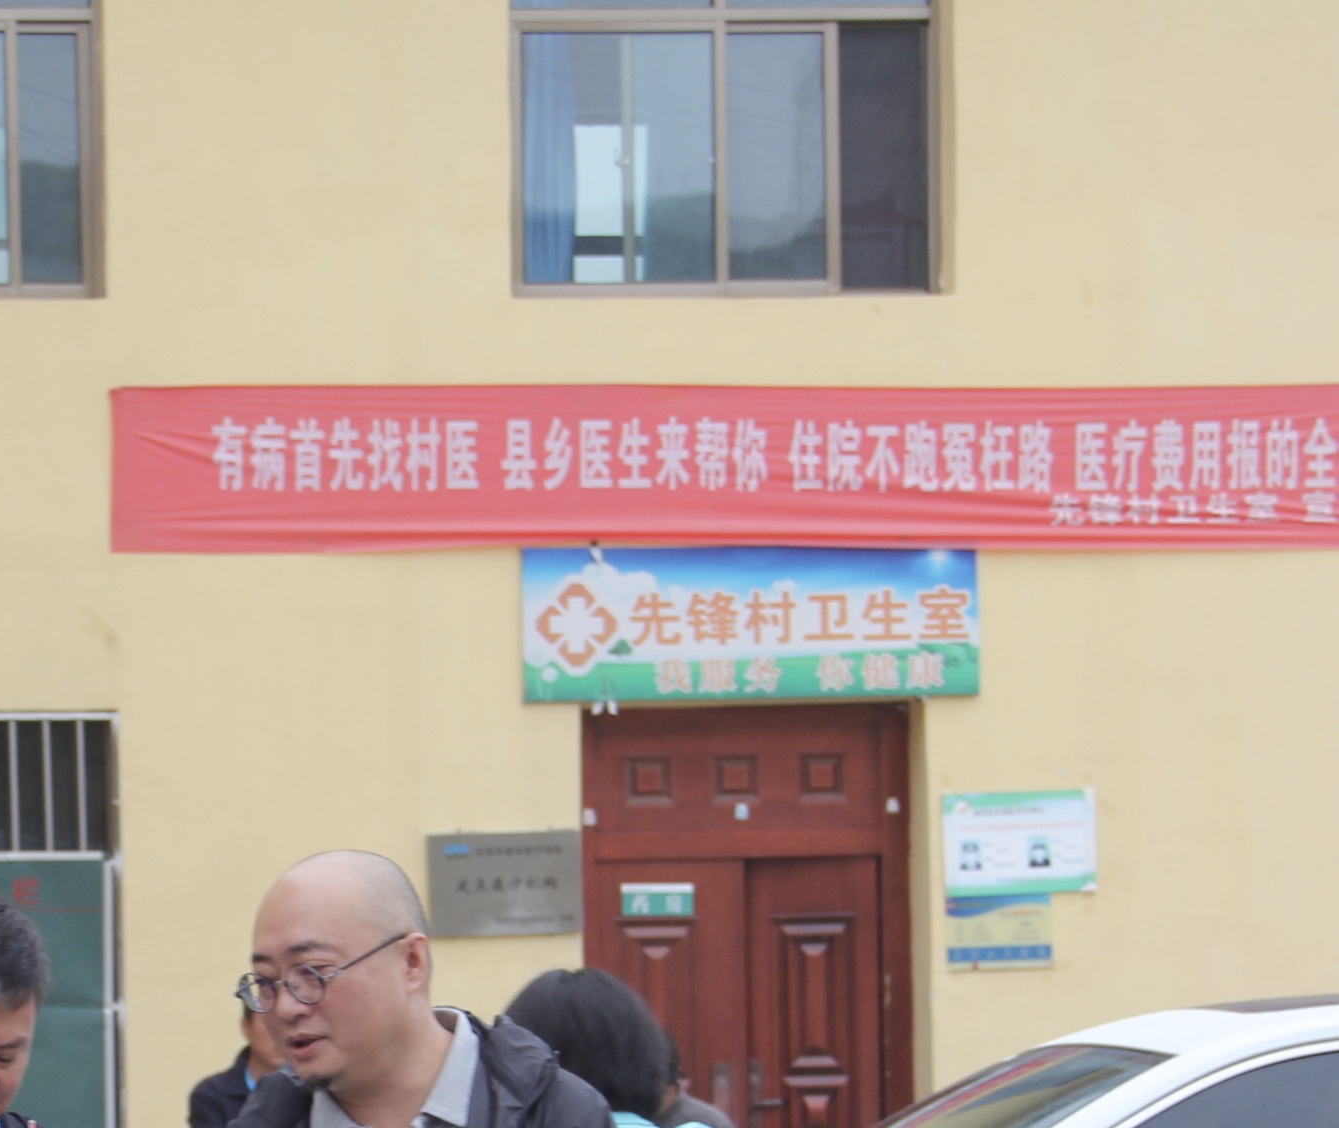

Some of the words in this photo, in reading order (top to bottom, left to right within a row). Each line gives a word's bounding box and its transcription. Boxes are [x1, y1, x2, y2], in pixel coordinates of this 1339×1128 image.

[210, 416, 480, 492] 有病首先找村医
[500, 416, 767, 493] 县乡医生来帮你
[788, 418, 1054, 494] 住院不跑冤枉路
[1073, 416, 1338, 493] 医疗费用报的全
[629, 585, 971, 647] 先锋村卫生室
